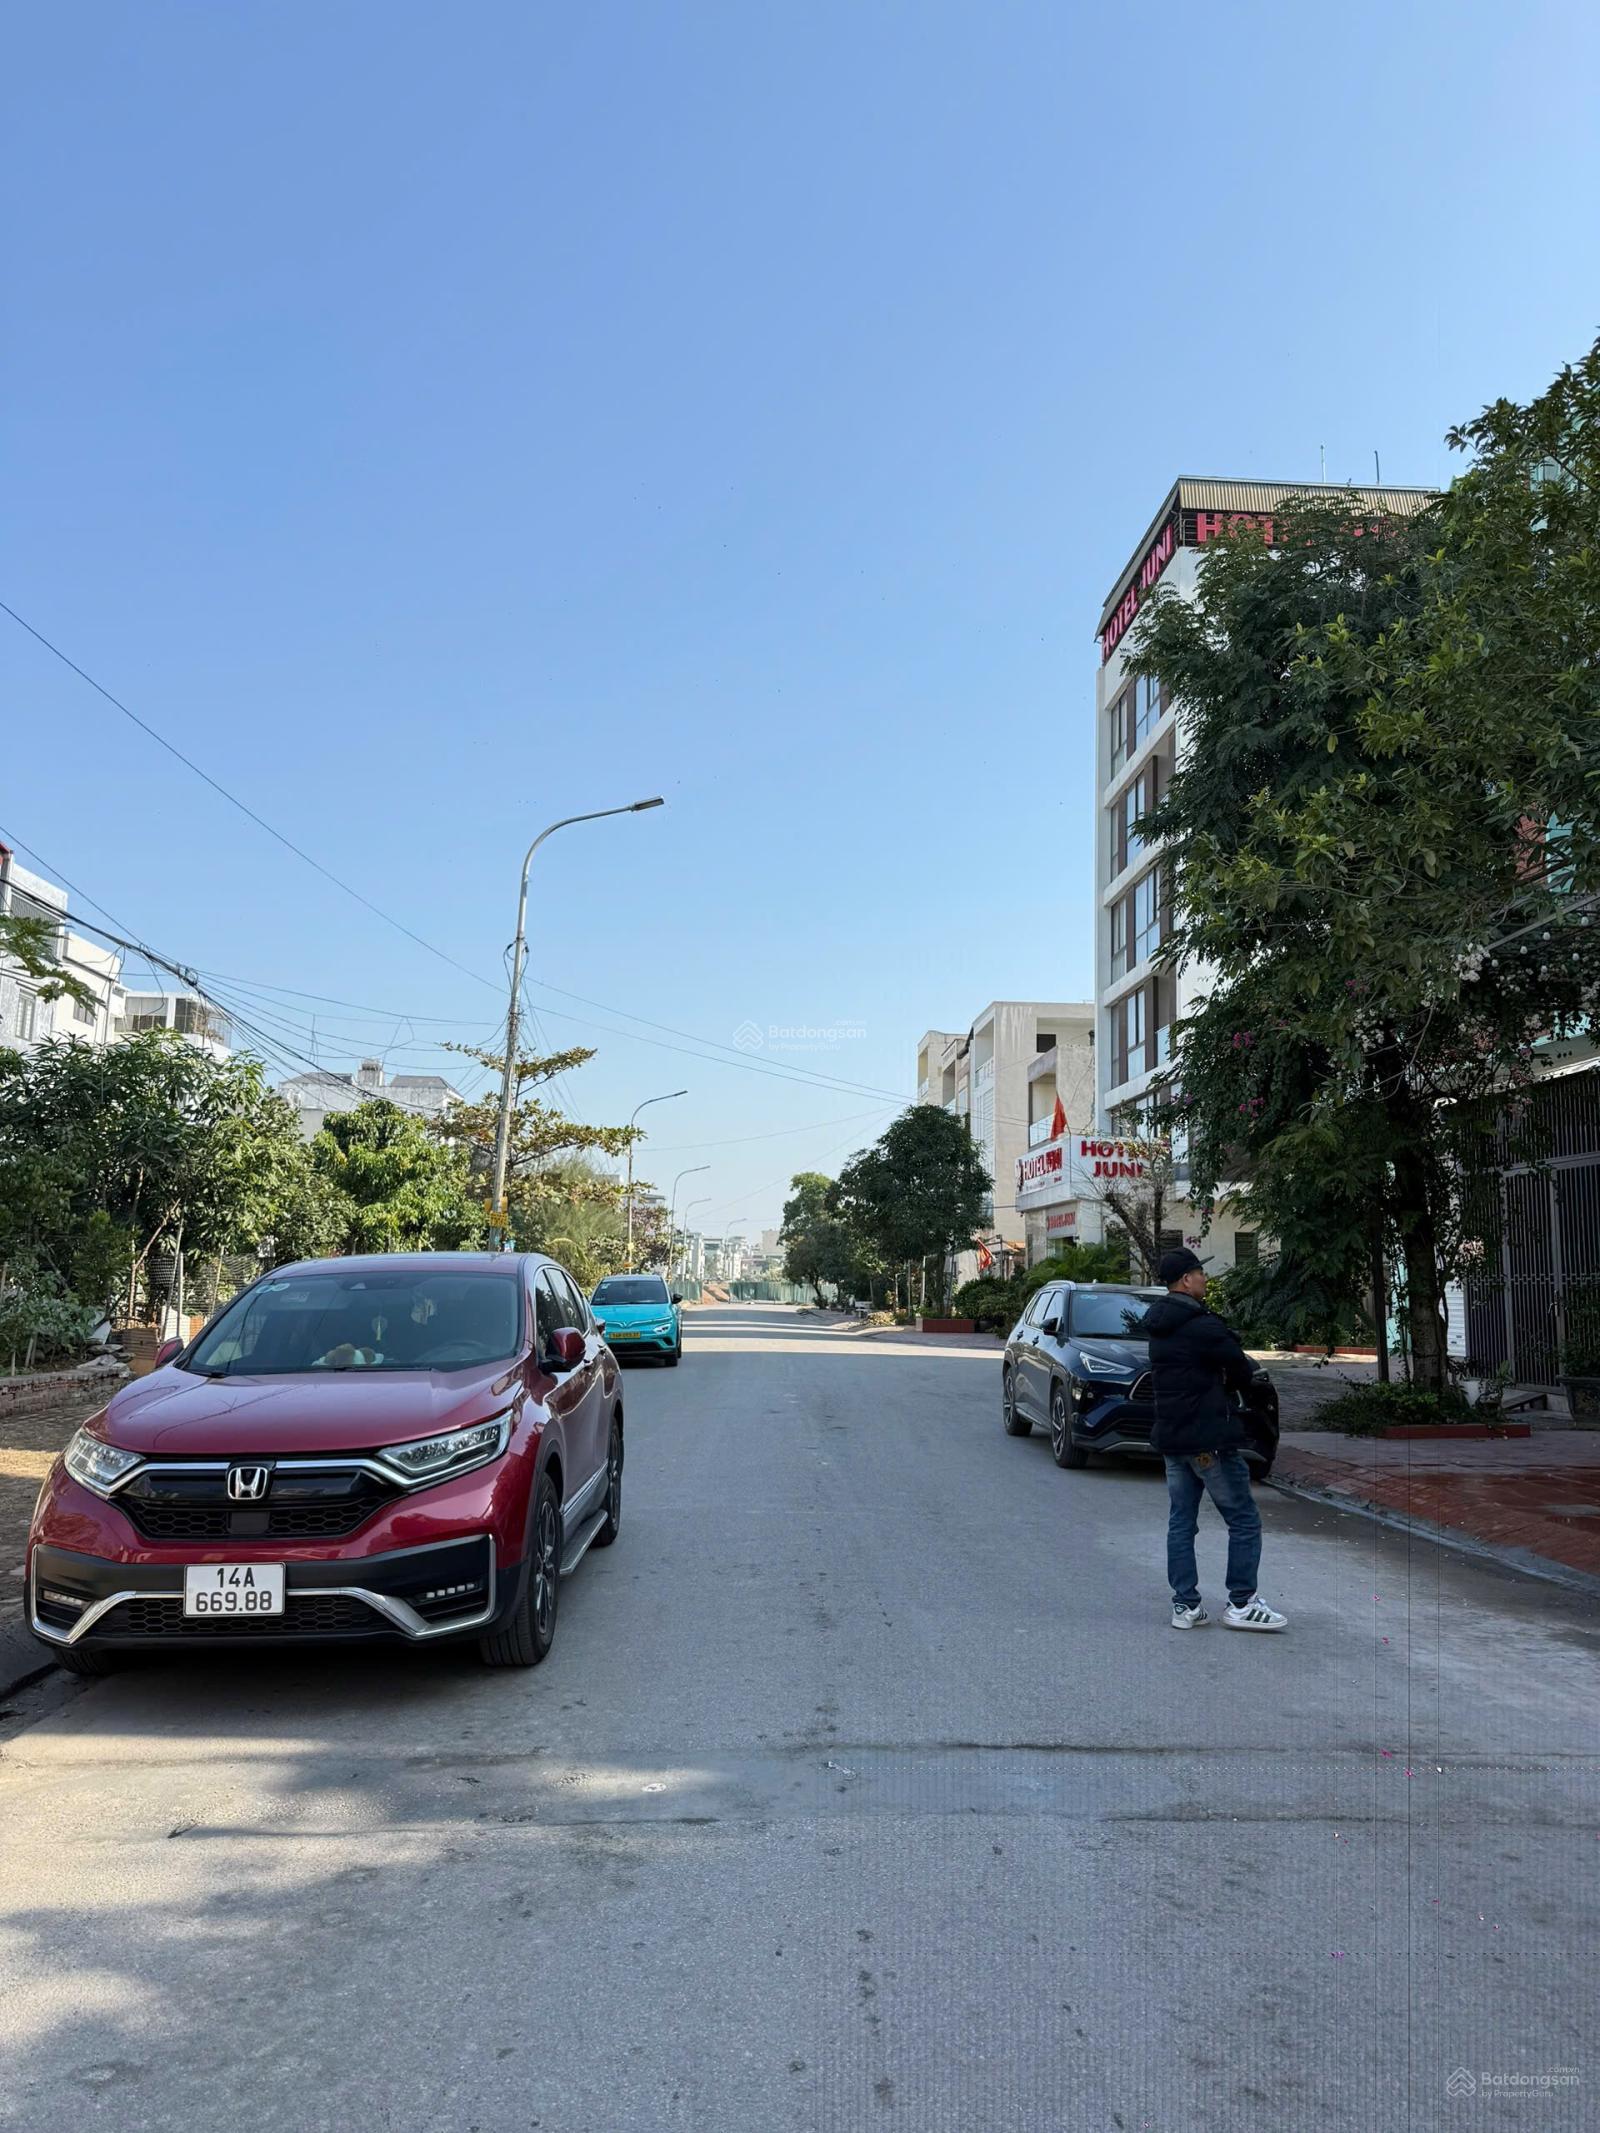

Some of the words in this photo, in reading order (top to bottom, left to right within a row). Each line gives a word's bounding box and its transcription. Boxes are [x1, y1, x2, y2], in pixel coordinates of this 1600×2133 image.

[1101, 585, 1138, 665] HOTEL
[1024, 1155, 1046, 1180] HOTEL
[1093, 1161, 1143, 1178] JUNI
[217, 1567, 255, 1588] 14A
[196, 1590, 272, 1612] 669.88
